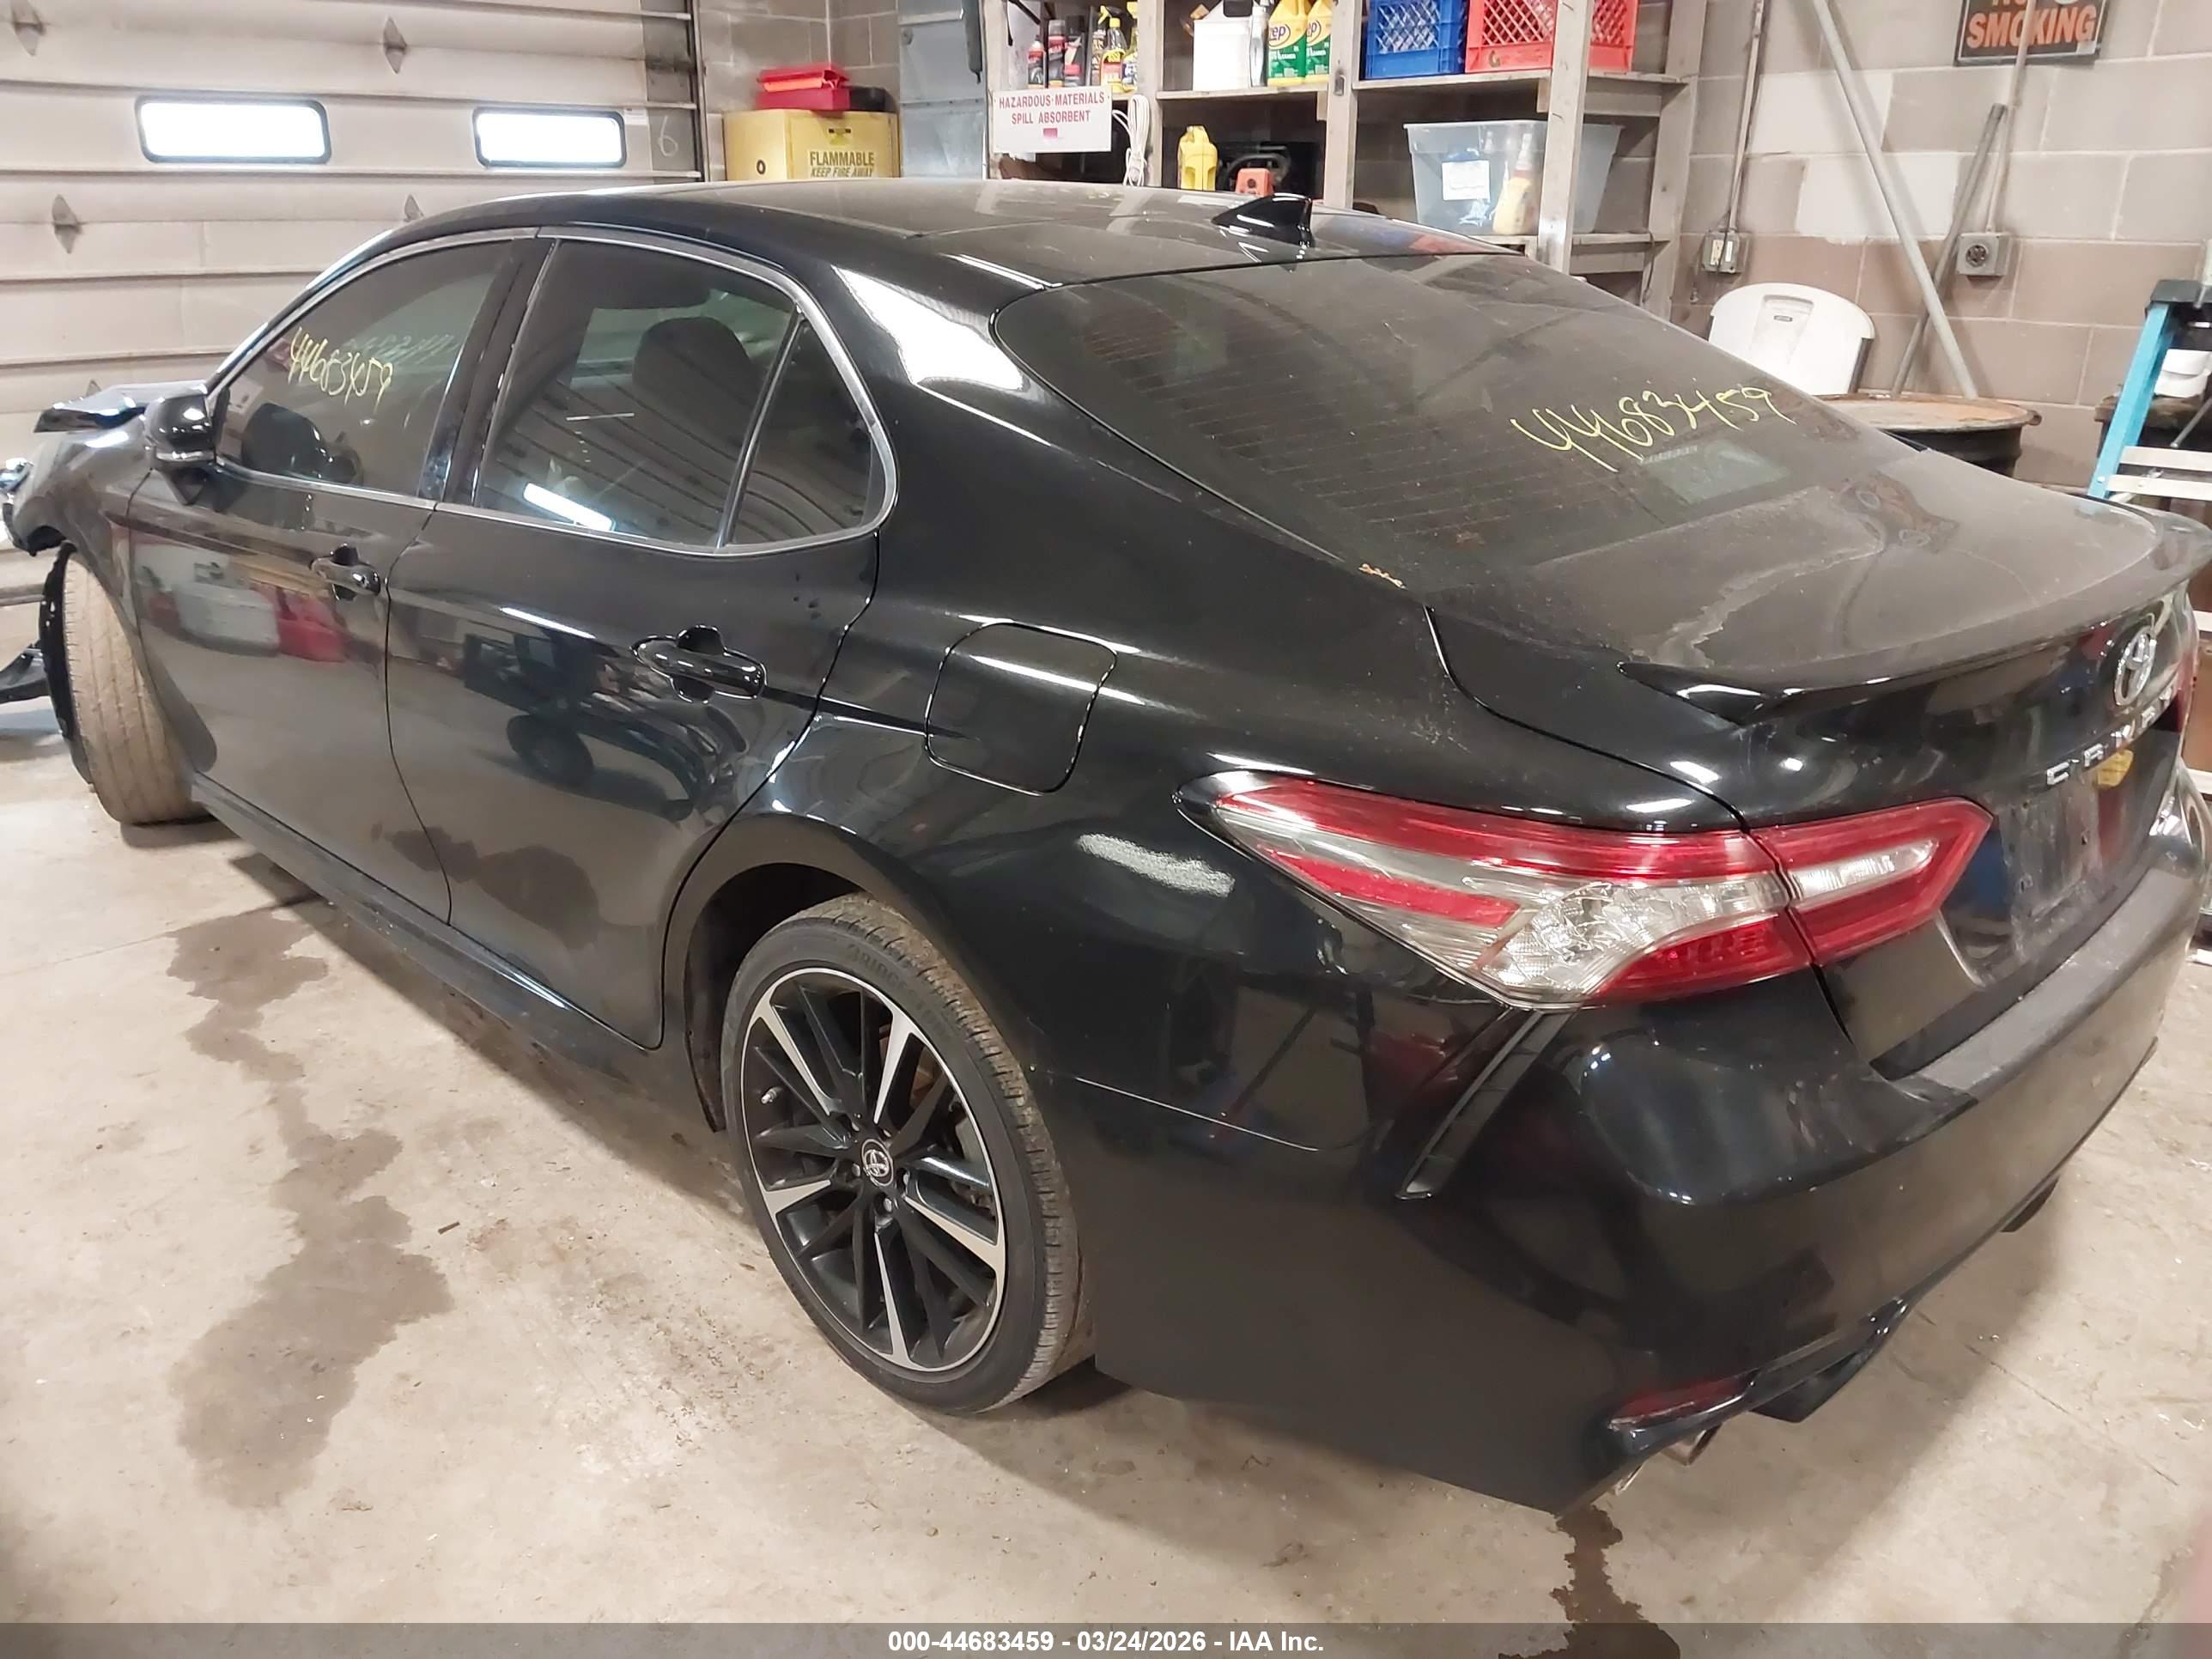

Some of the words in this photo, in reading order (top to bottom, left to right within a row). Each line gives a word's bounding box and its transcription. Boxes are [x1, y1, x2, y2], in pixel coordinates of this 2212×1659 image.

[1967, 5, 2097, 48] SMOKING
[999, 94, 1052, 109] HAZARDOUS
[1054, 91, 1105, 106] MATERIALS
[1012, 113, 1034, 125] SPILL
[1038, 110, 1091, 124] ABSORBENT
[658, 114, 678, 156] 6
[809, 150, 875, 167] FLAMMABLE
[810, 166, 832, 178] KEEP
[833, 167, 851, 178] FIRE
[1509, 386, 1799, 473] 44683459
